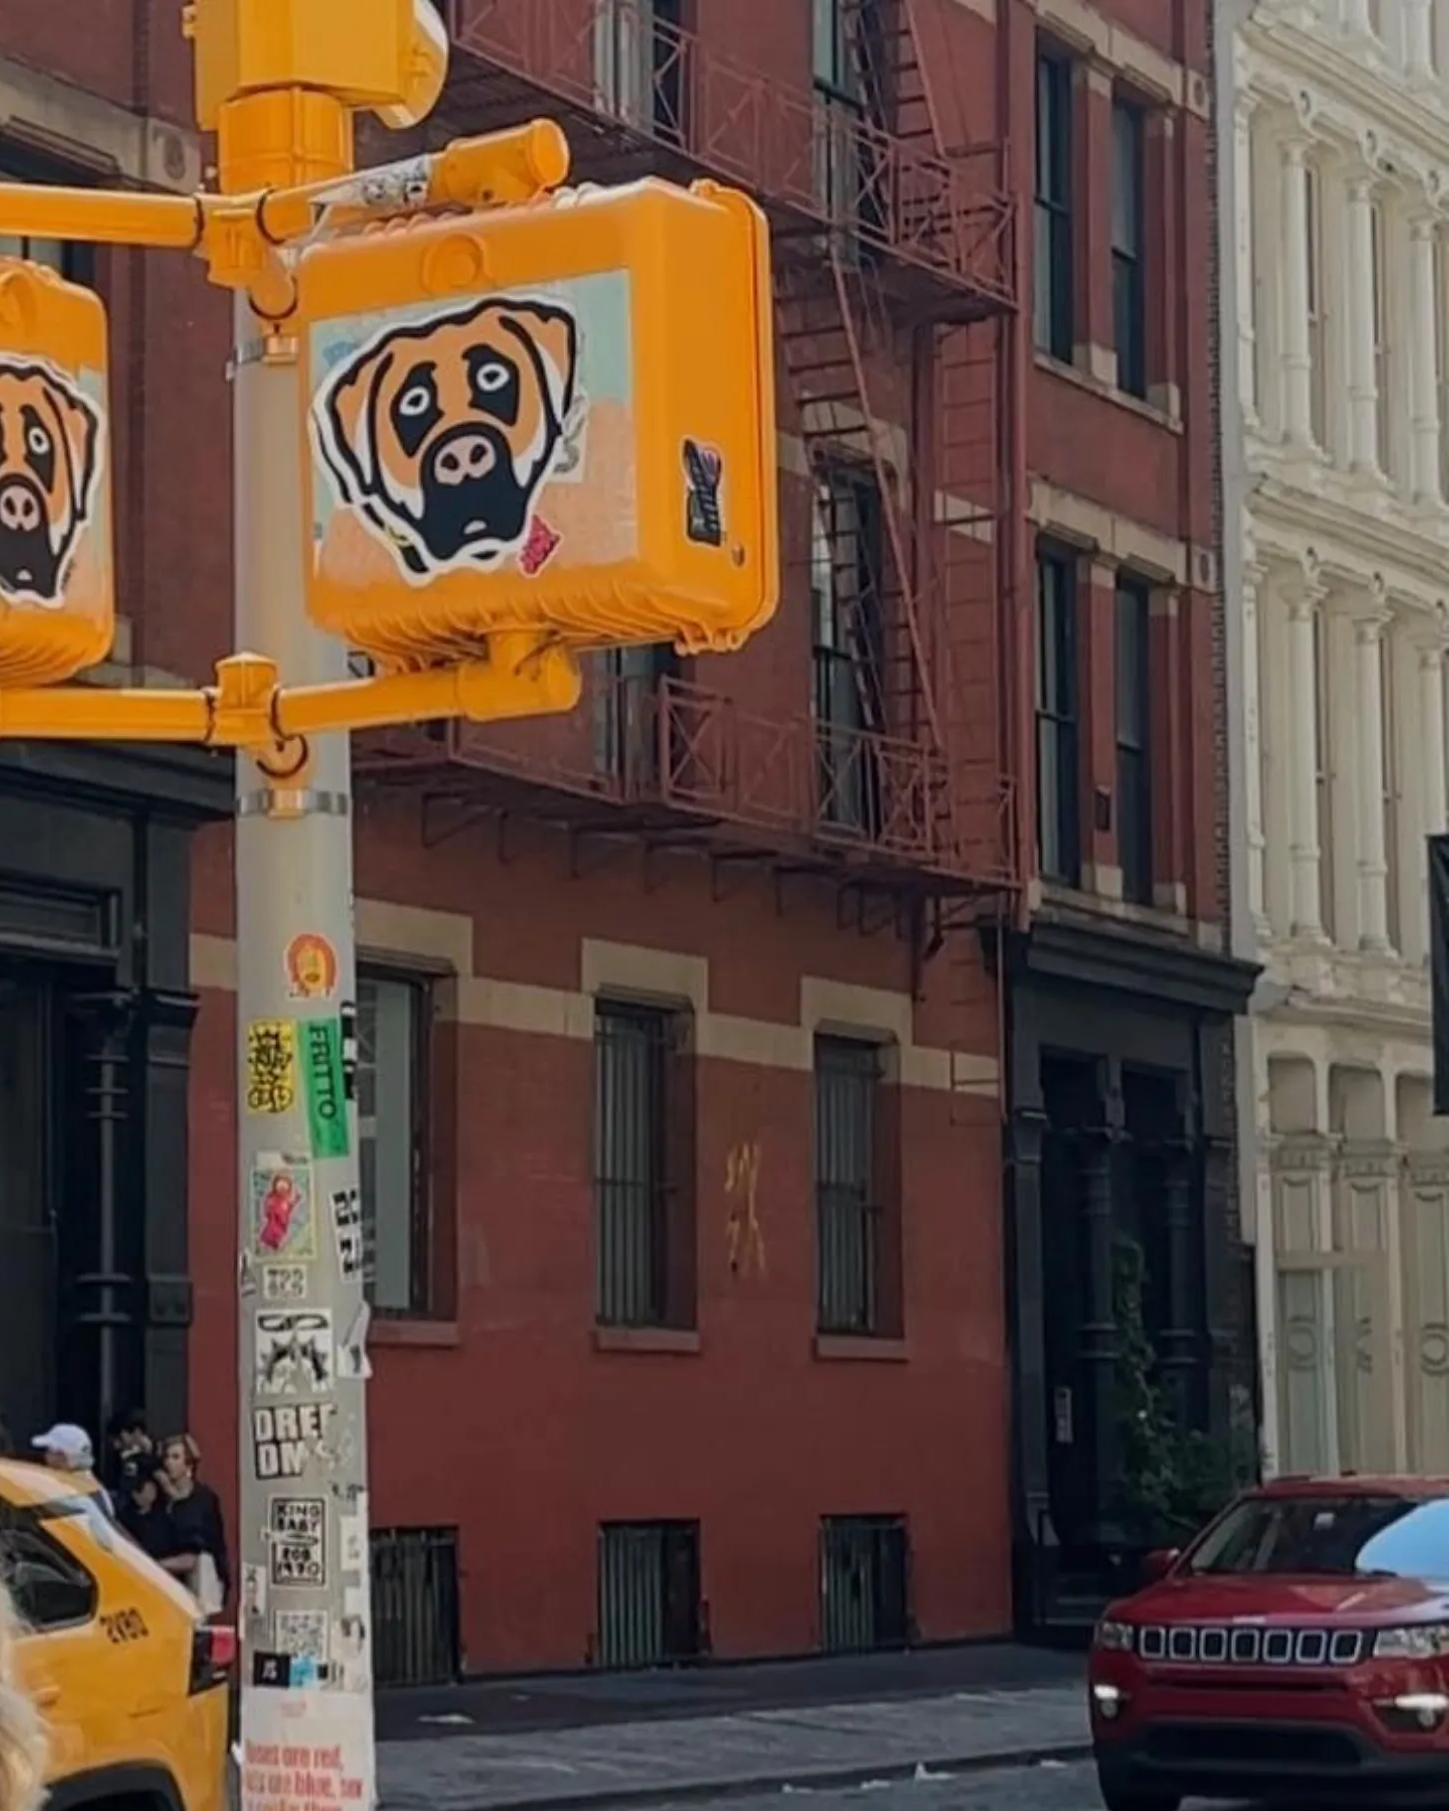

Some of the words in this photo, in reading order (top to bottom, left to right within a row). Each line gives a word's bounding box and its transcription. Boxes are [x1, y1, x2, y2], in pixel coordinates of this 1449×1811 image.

[308, 1025, 338, 1120] FRITTO
[277, 1504, 320, 1517] KING
[278, 1518, 319, 1531] BABY
